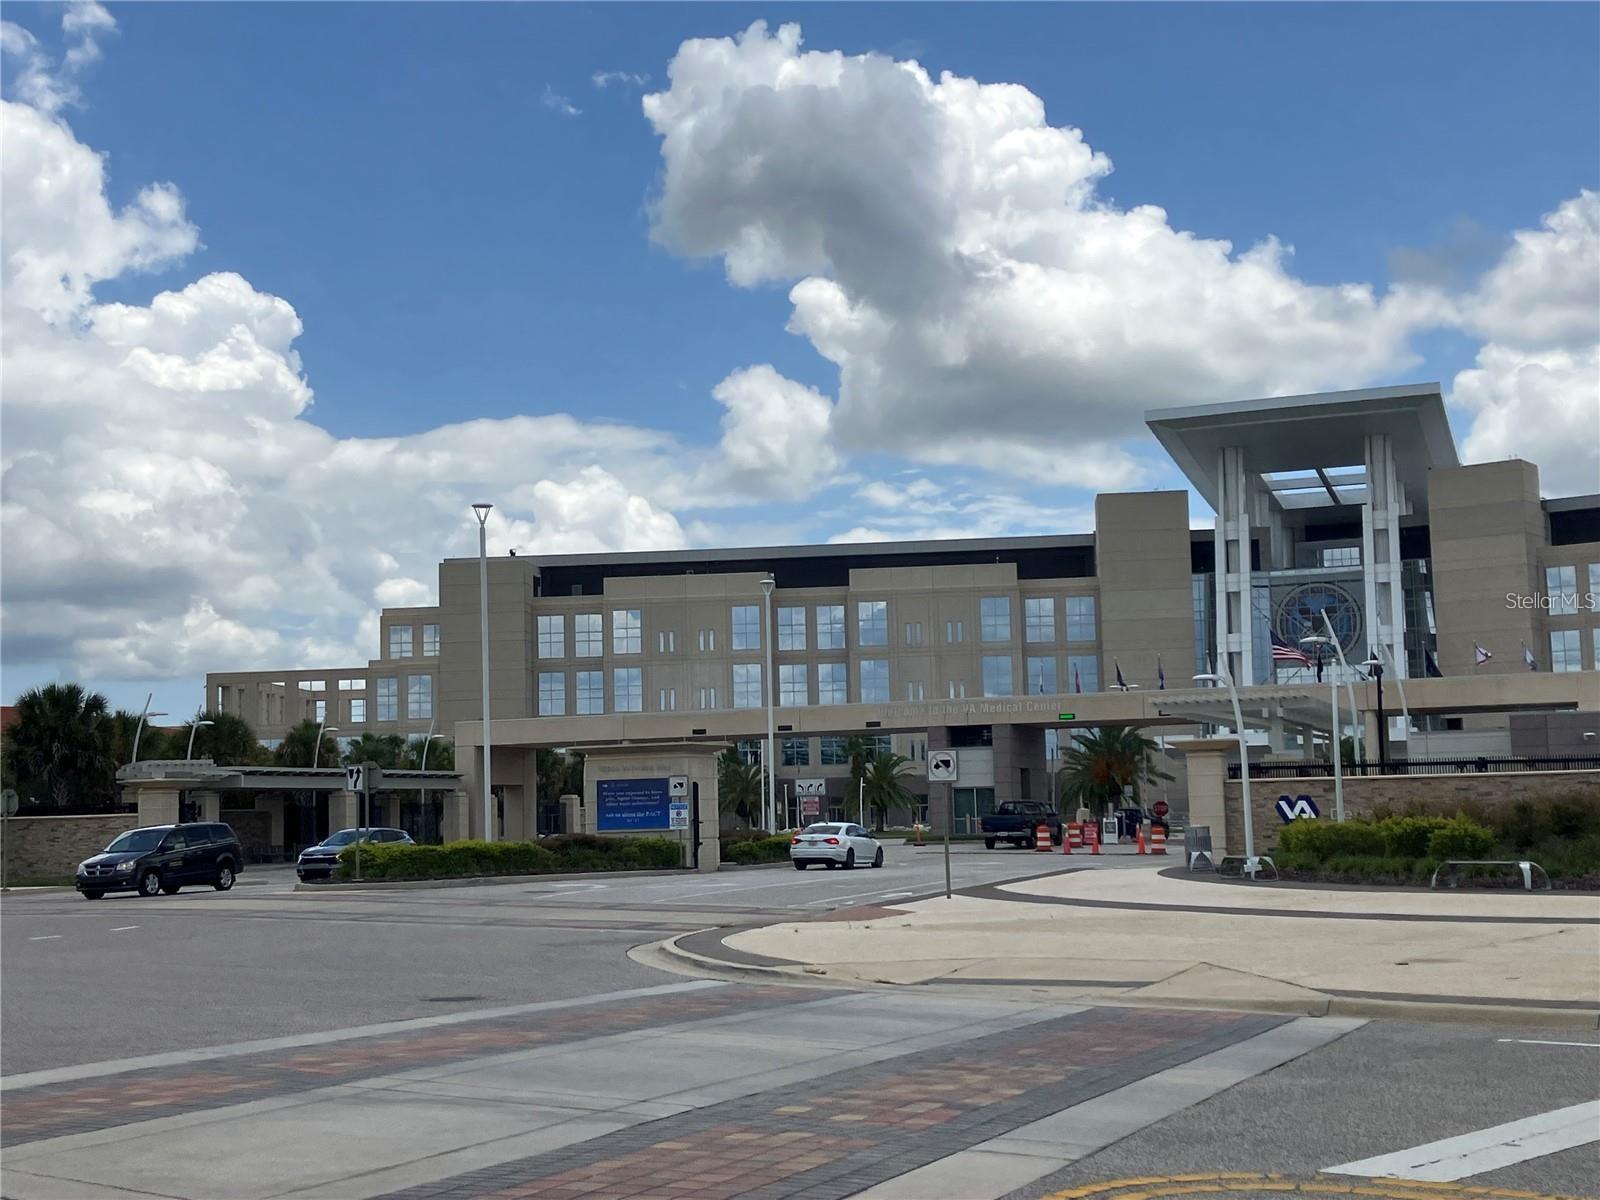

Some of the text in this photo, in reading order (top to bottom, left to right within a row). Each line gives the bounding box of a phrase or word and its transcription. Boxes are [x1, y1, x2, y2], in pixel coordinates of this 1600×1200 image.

[962, 703, 976, 713] VA
[980, 702, 1022, 713] Medical
[1277, 799, 1318, 820] VA
